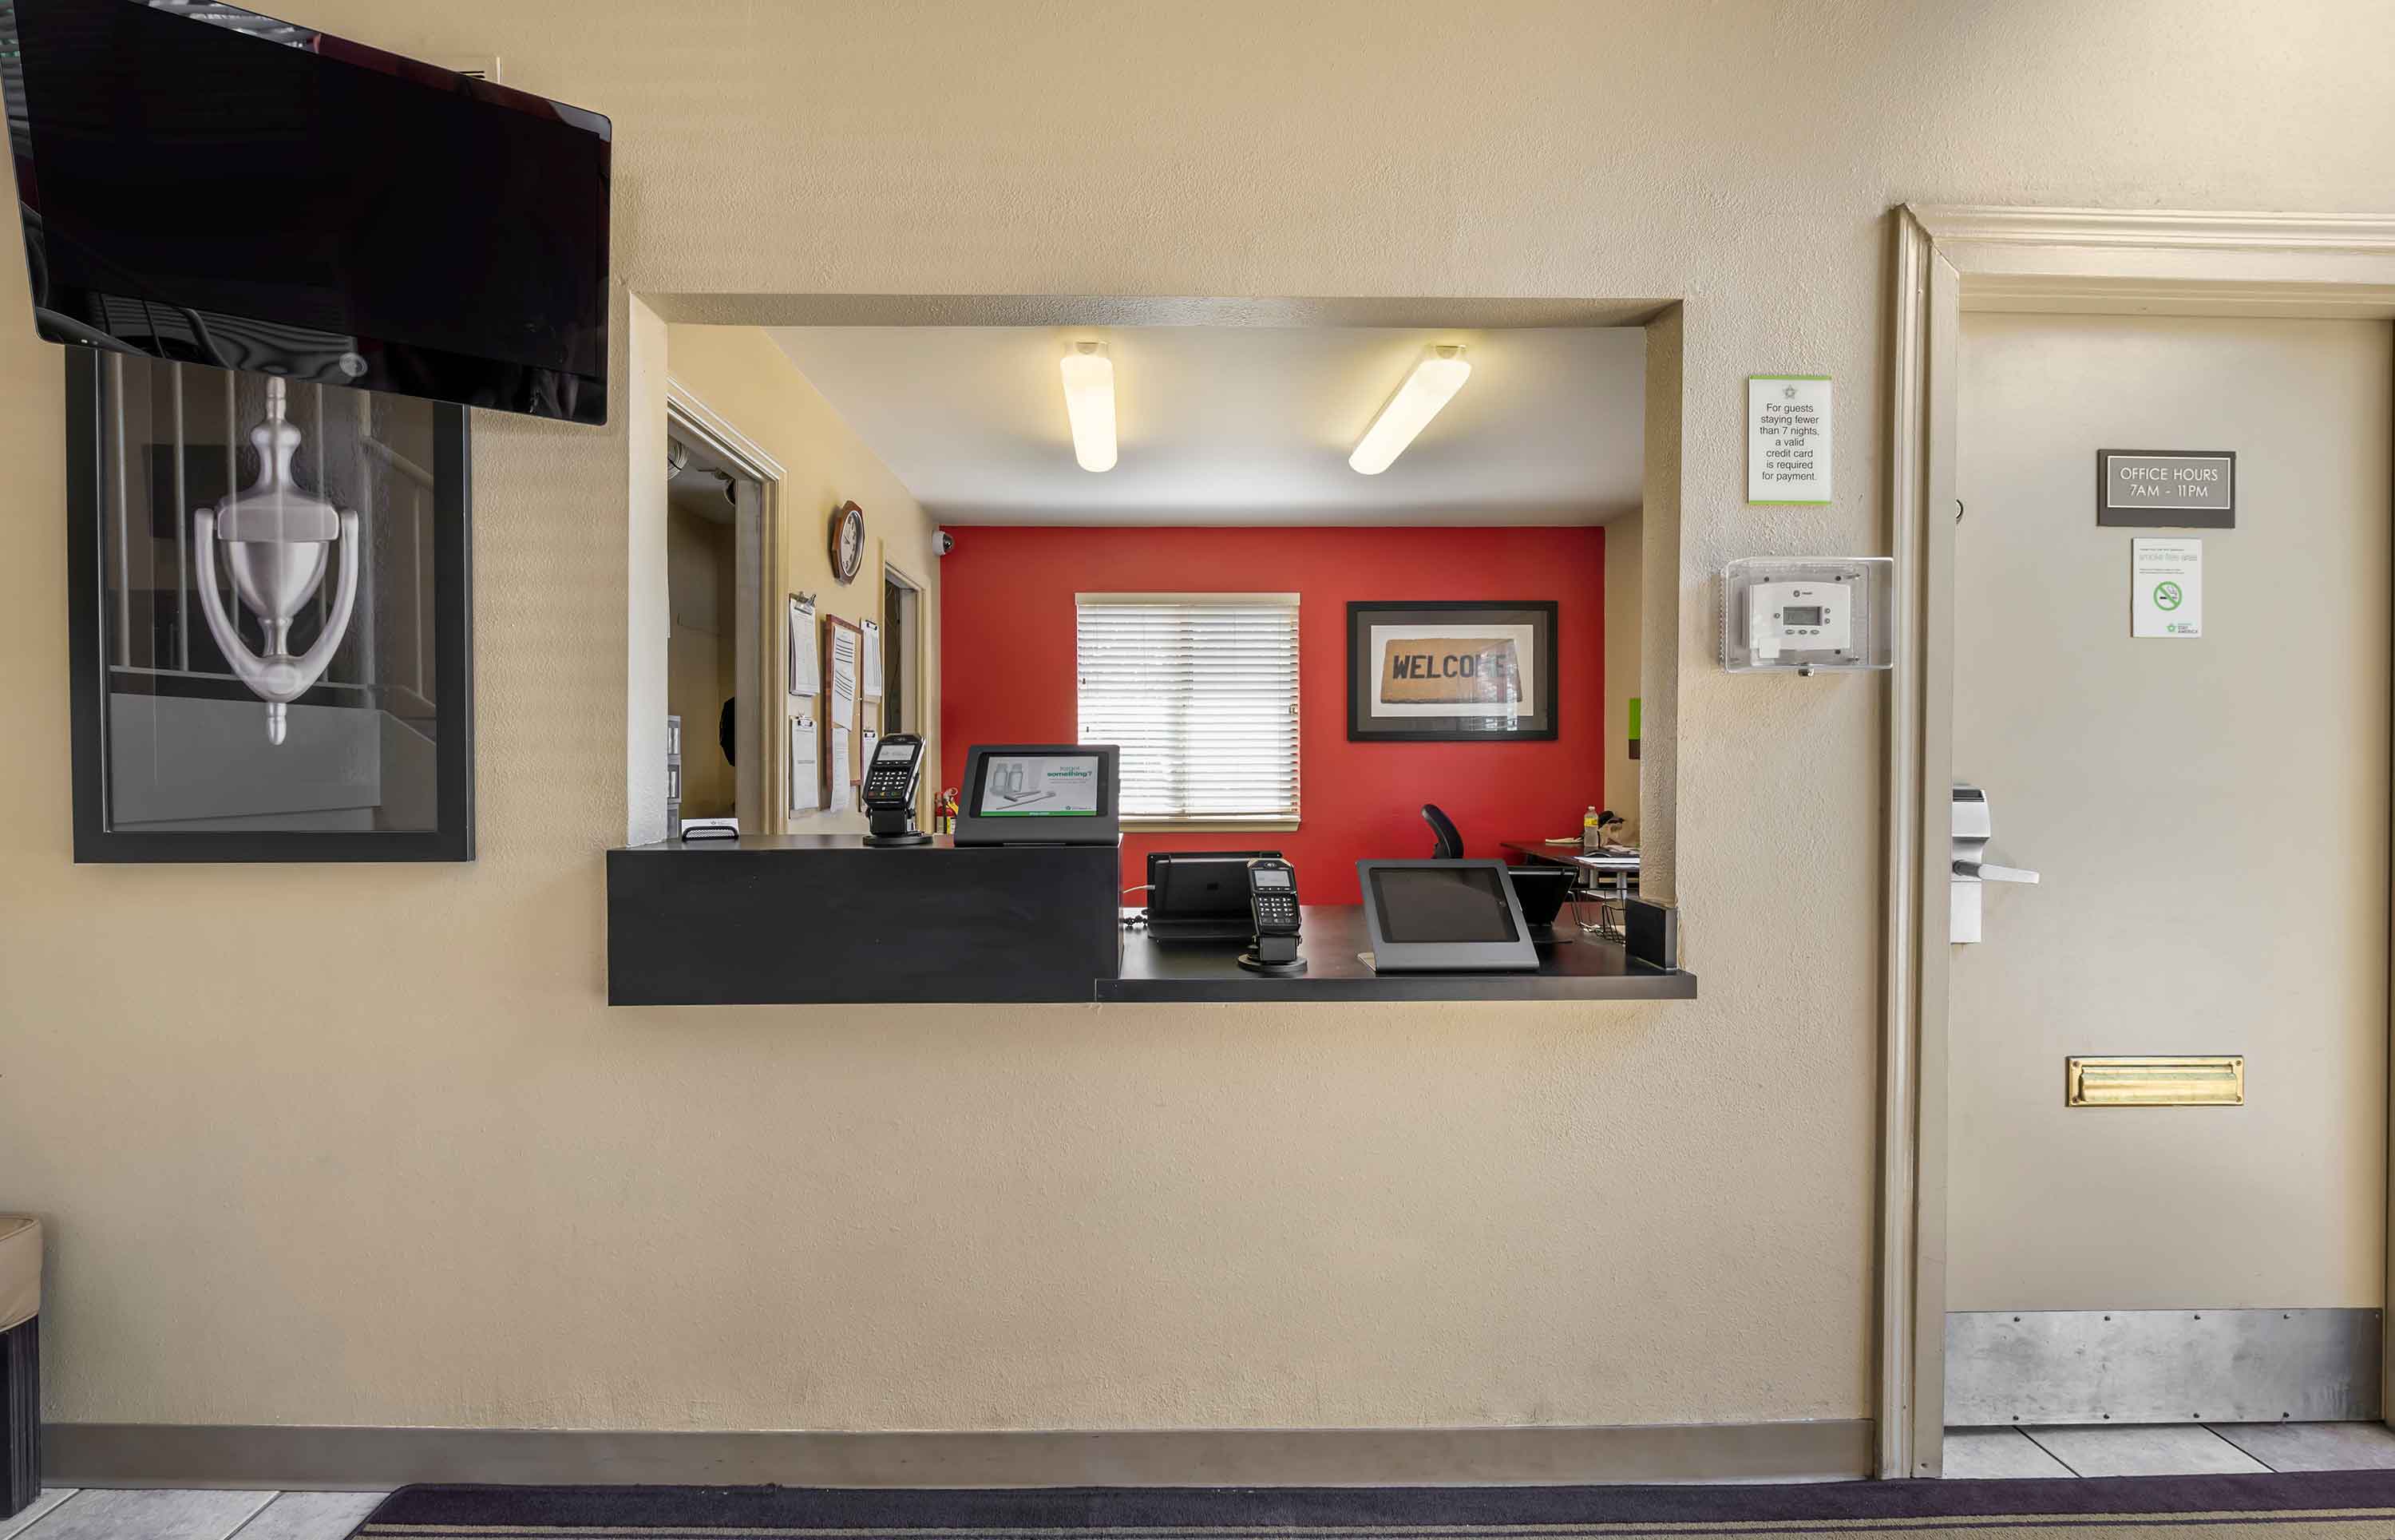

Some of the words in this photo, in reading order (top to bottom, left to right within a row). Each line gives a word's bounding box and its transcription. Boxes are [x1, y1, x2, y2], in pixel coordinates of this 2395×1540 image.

[1767, 403, 1781, 413] For
[1783, 404, 1814, 414] guests
[1760, 415, 1792, 426] staying
[1795, 415, 1819, 424] fewer
[1760, 426, 1779, 435] than
[1782, 426, 1787, 435] 7
[1791, 426, 1819, 437] nights,
[1776, 461, 1813, 470] required
[2120, 467, 2168, 481] OFFICE
[2173, 468, 2219, 481] HOURS
[2129, 484, 2159, 497] 7AM
[2178, 485, 2209, 497] 11PM
